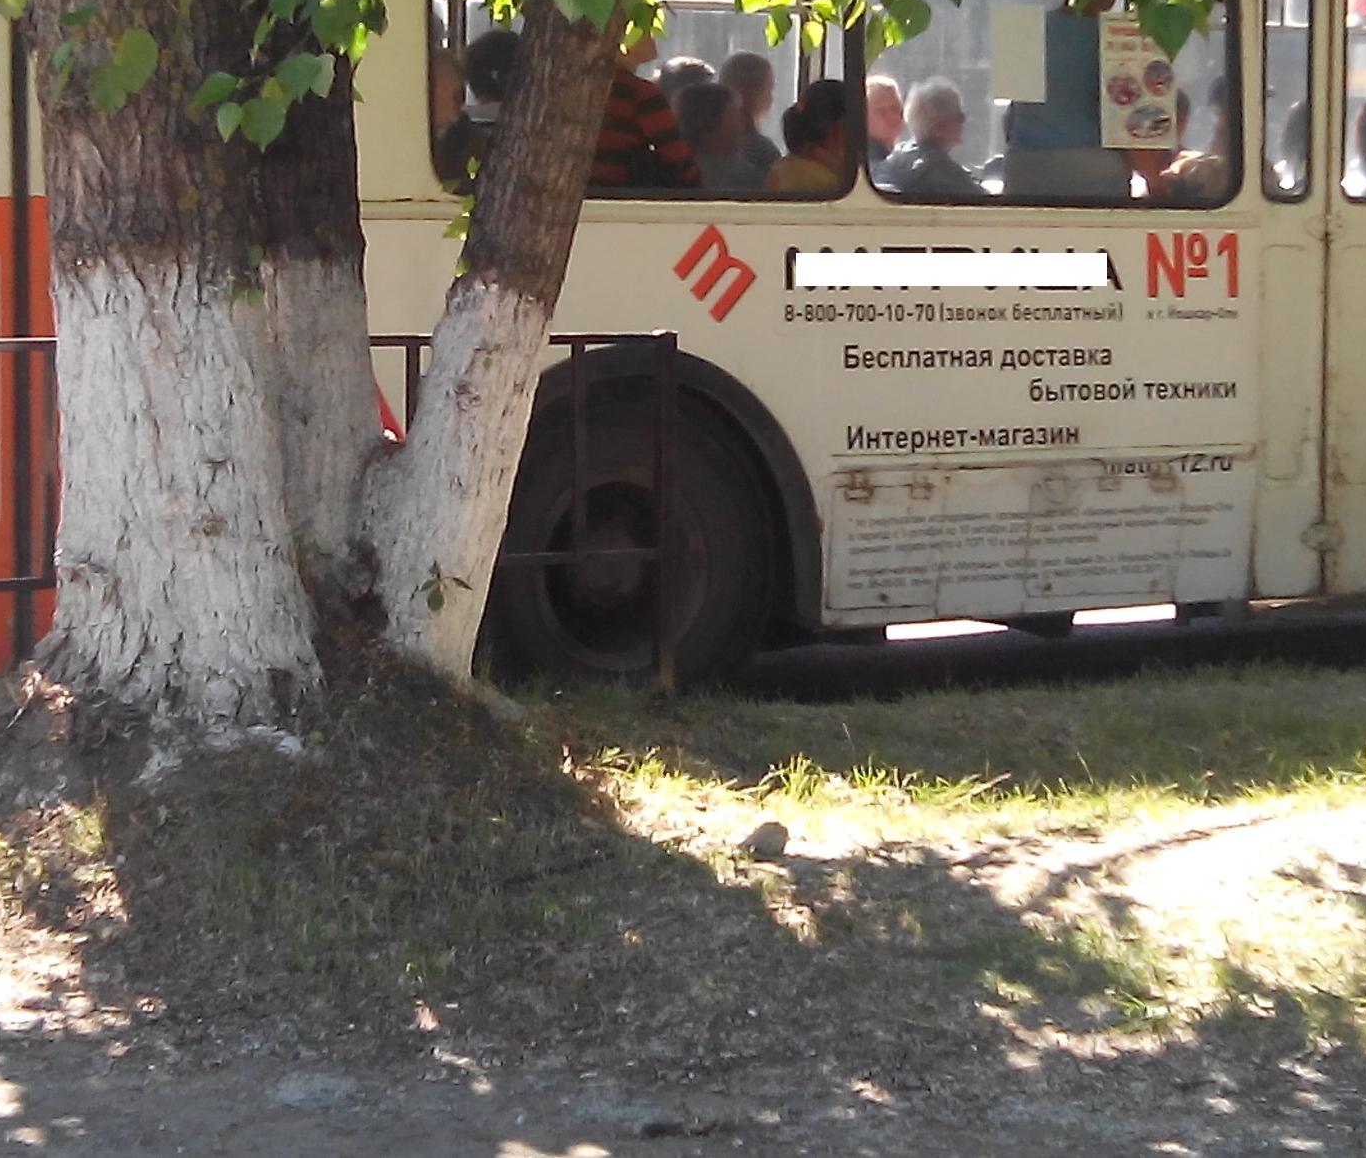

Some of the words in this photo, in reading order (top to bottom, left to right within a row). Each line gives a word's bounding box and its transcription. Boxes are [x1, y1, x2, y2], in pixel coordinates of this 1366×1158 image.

[1146, 231, 1239, 299] №1
[784, 303, 935, 322] 8-800-700-10-70
[939, 301, 1007, 322] (звонок
[1012, 301, 1124, 321] бесплатный)
[843, 344, 993, 369] Бесплатная
[999, 348, 1113, 371] доставка
[1029, 377, 1136, 402] бытовой
[1143, 381, 1237, 400] техники
[846, 425, 1080, 453] Интернет-магазин
